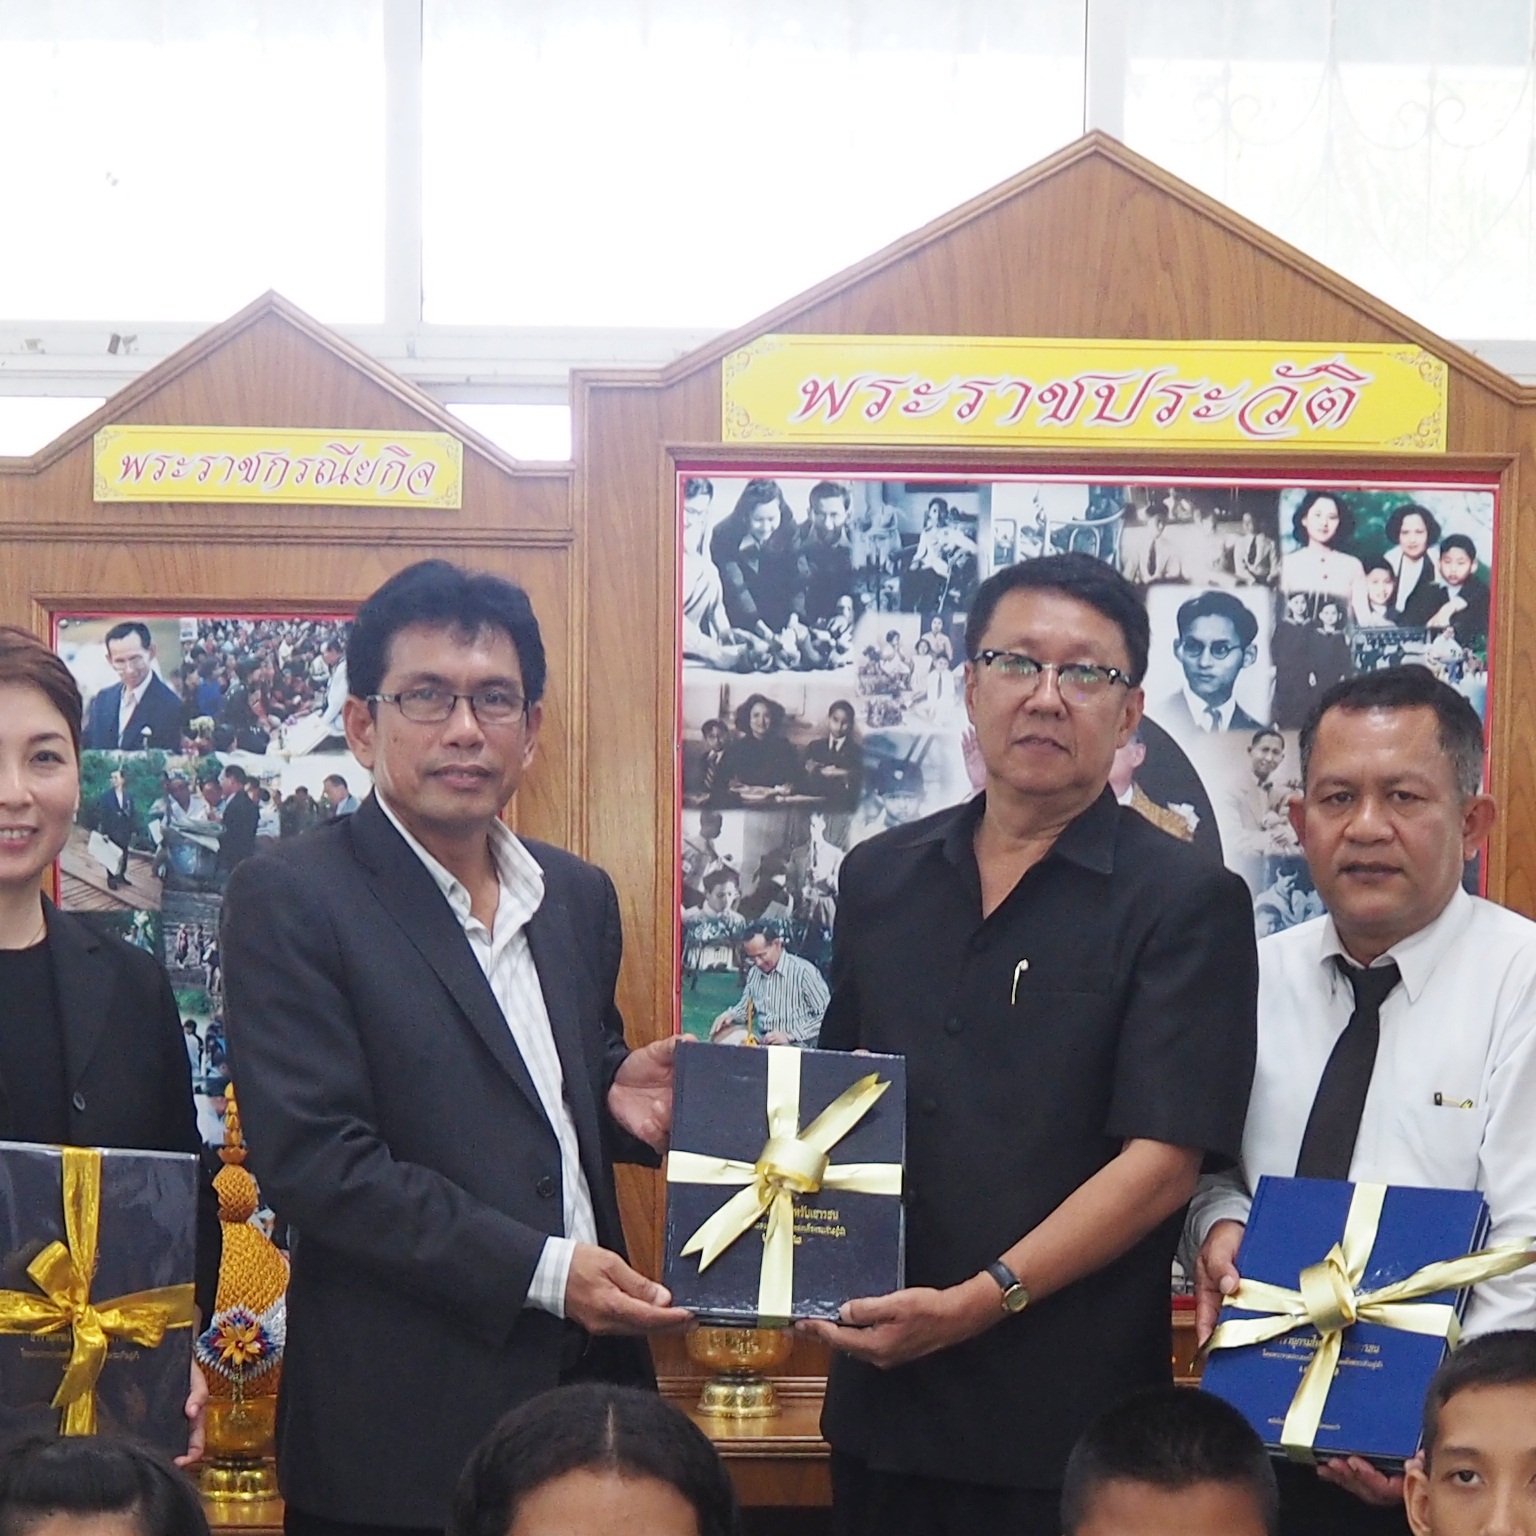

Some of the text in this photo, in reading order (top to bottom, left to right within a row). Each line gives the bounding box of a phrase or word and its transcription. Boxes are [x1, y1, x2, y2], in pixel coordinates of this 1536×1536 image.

[796, 358, 1367, 436] พระราชประวัติ
[120, 442, 438, 495] พระราชกรณียกิจ
